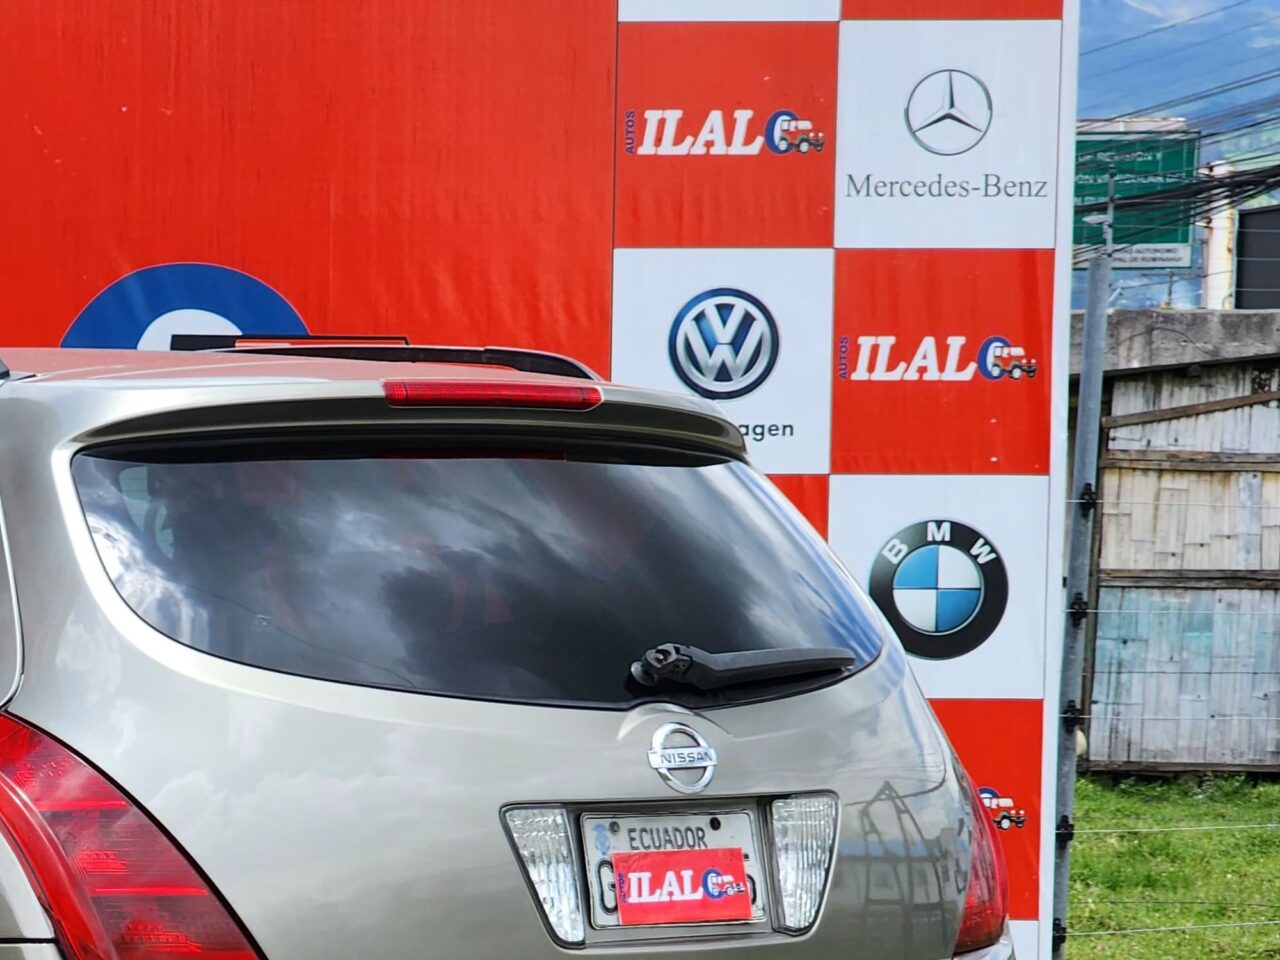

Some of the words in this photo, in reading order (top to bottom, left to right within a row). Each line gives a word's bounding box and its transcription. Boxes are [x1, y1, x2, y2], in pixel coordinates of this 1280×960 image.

[624, 110, 636, 154] AUTOS
[846, 173, 1049, 198] Mercedes-Benz
[838, 336, 849, 380] AUTOS
[880, 521, 998, 565] BMW
[660, 751, 714, 764] NISSAN
[627, 826, 708, 850] ECUADOR
